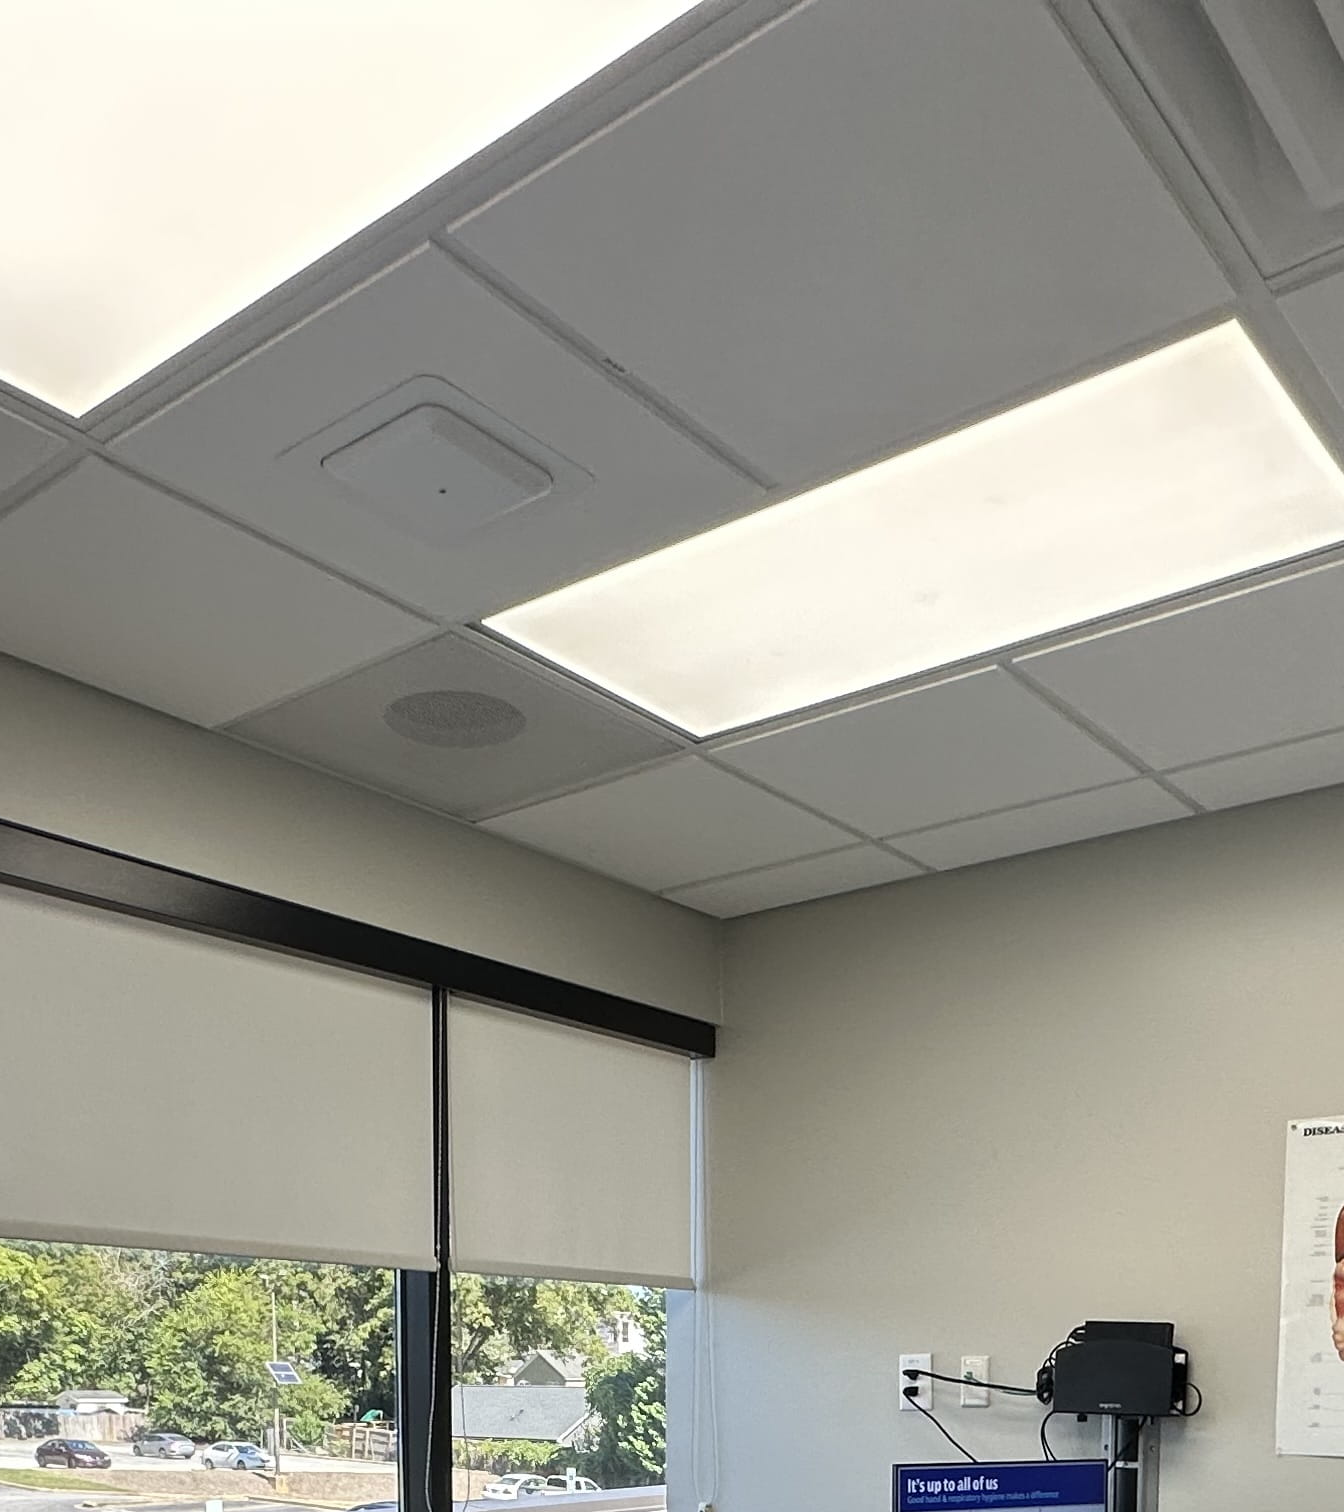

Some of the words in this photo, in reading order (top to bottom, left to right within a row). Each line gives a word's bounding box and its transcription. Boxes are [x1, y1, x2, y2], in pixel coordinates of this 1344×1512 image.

[907, 1478, 925, 1493] It's
[927, 1480, 942, 1494] up
[943, 1478, 955, 1492] to
[957, 1476, 971, 1491] all
[972, 1475, 985, 1490] of
[986, 1478, 998, 1490] us
